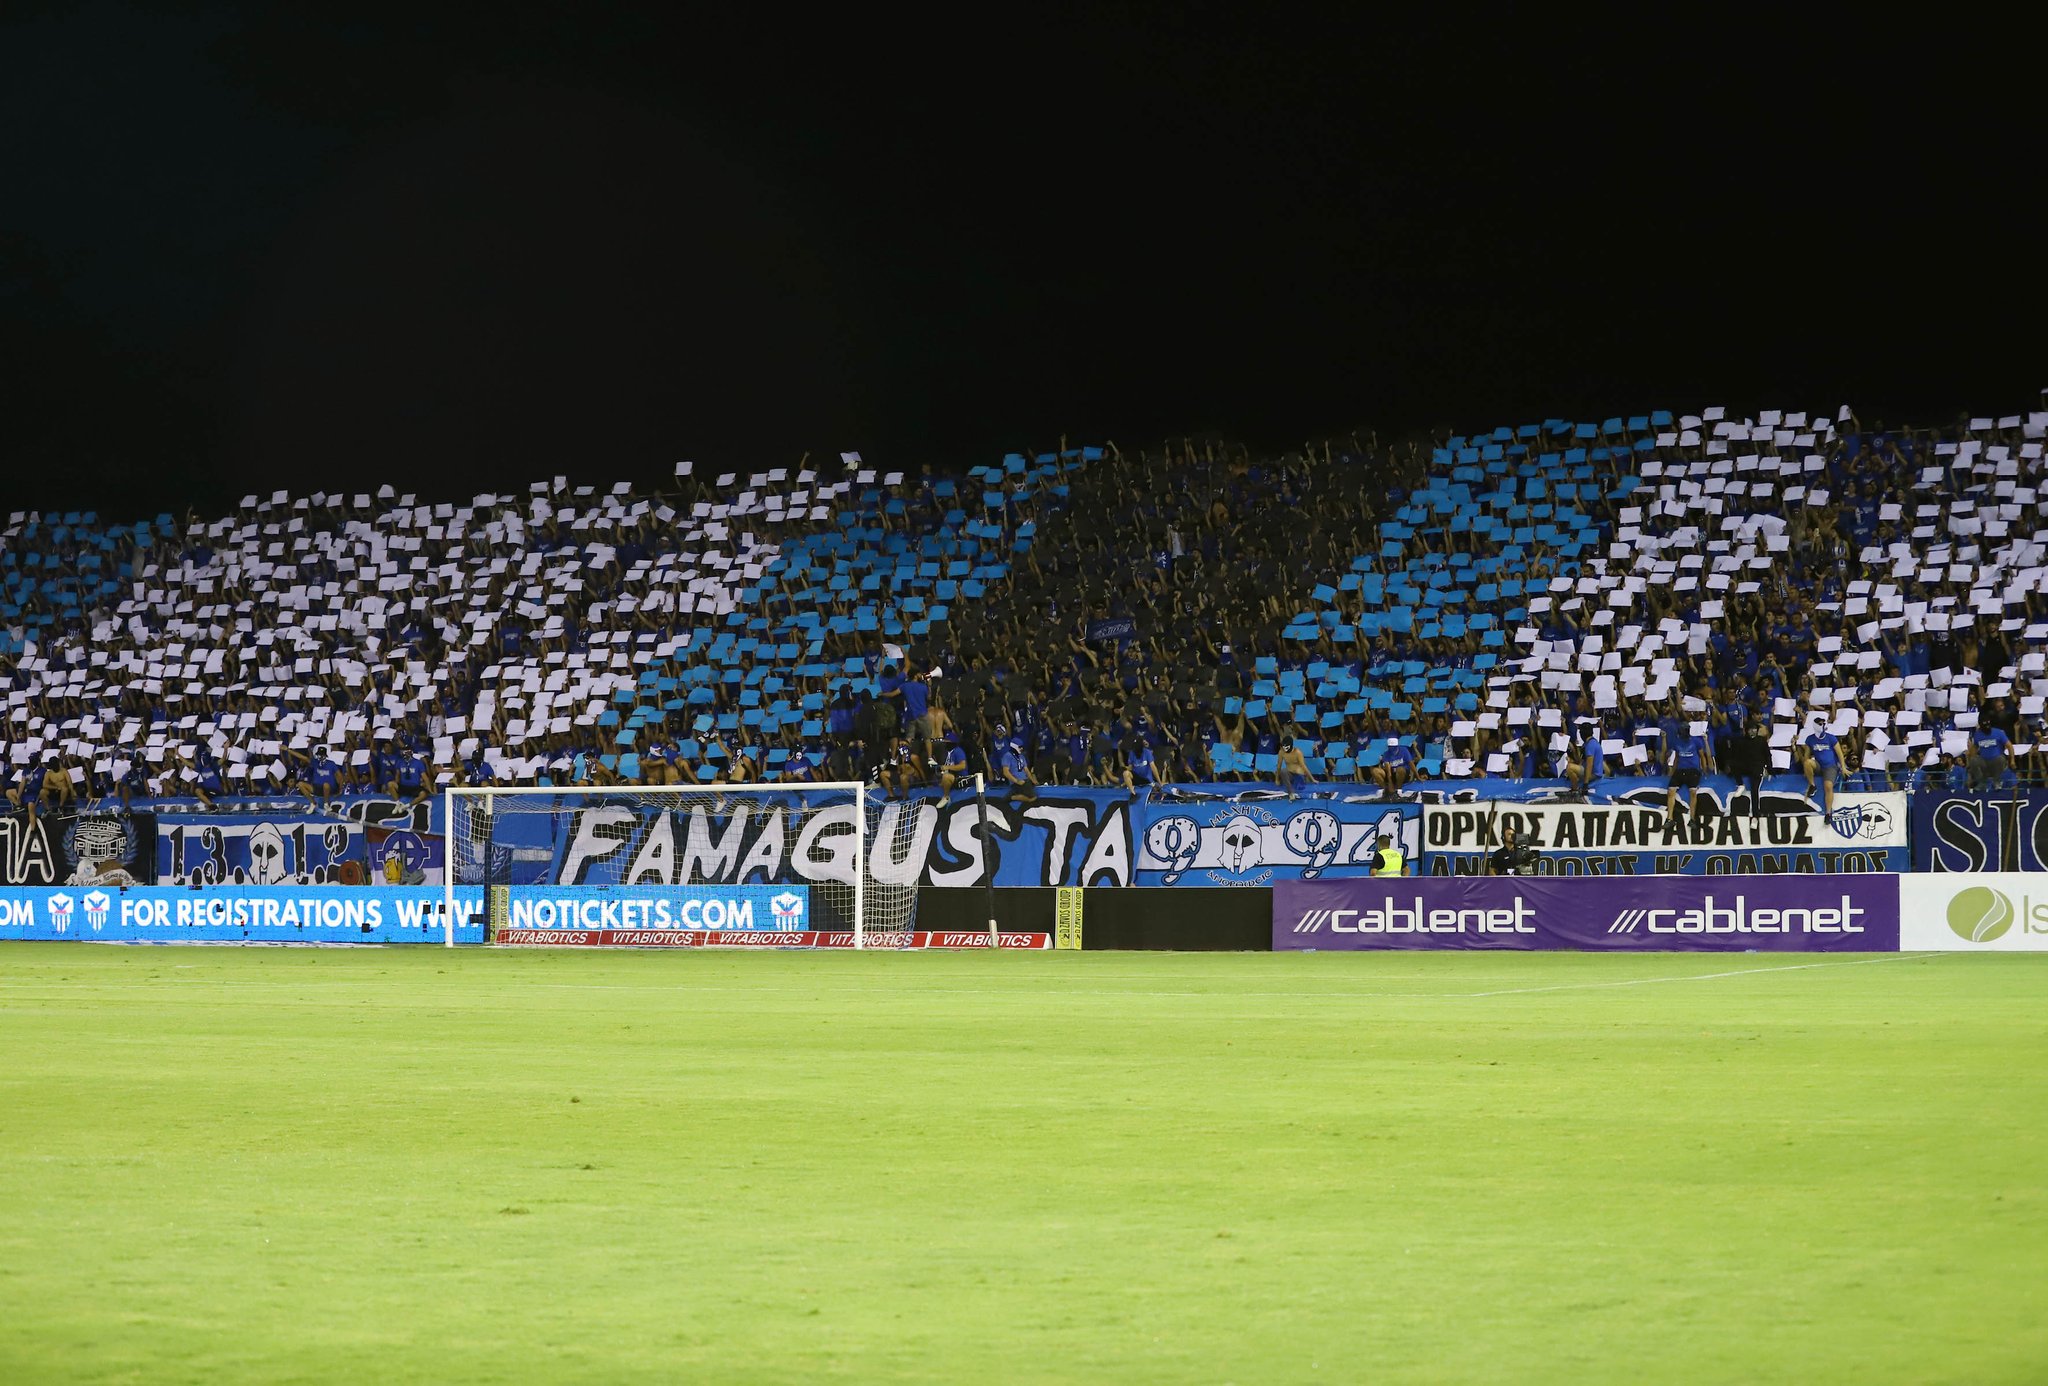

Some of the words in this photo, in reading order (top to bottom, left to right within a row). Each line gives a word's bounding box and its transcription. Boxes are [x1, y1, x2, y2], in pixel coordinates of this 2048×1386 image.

[557, 802, 1131, 886] FAMAGUSTA
[120, 899, 170, 927] FOR
[177, 898, 382, 928] REGISTRATIONS
[1331, 897, 1536, 933] cablenet
[1648, 895, 1864, 933] cablenet
[508, 931, 589, 944] VITABIOTICS
[612, 932, 694, 945] VITABIOTICS
[719, 932, 804, 945] VITABIOTICS
